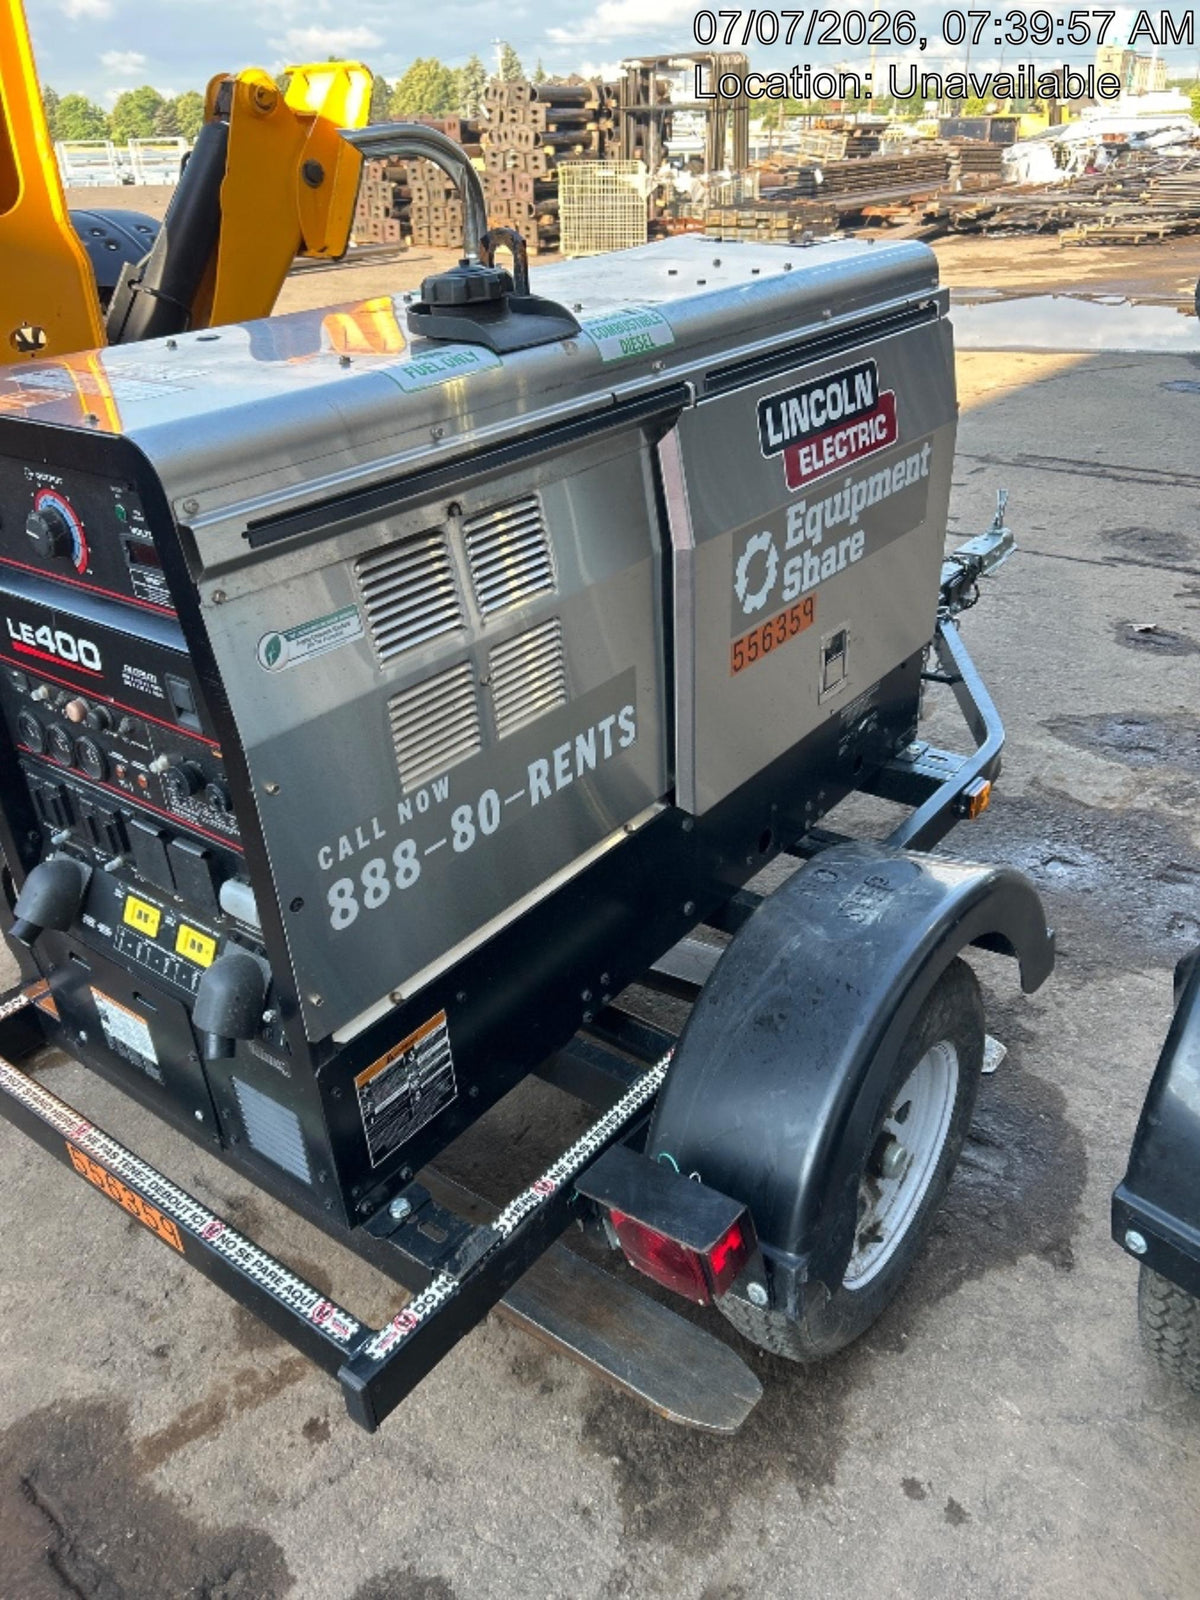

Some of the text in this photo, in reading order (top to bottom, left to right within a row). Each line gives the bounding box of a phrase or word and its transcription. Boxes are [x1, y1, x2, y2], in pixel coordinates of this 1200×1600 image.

[403, 357, 443, 380] FUEL
[444, 349, 481, 369] ONLY
[590, 314, 663, 340] COMBUSTIBLE
[765, 369, 874, 447] LINCOLN
[798, 413, 887, 476] ELECTRIC
[785, 442, 932, 550] Equipment
[782, 529, 866, 602] Share
[6, 617, 102, 671] LE400
[733, 596, 814, 673] 556359
[317, 776, 449, 870] CALL NOW
[504, 1192, 539, 1222] HERE
[566, 1142, 589, 1163] PAS
[589, 1110, 622, 1141] TENEZ
[100, 1140, 119, 1160] PAS
[119, 1158, 150, 1185] TENEZ
[147, 1180, 192, 1215] DEBOUT
[190, 1210, 207, 1227] ICI
[216, 1232, 238, 1251] NO
[235, 1246, 252, 1263] SE
[251, 1261, 287, 1287] PARE
[283, 1283, 317, 1311] AQUI
[413, 1293, 436, 1314] DO
